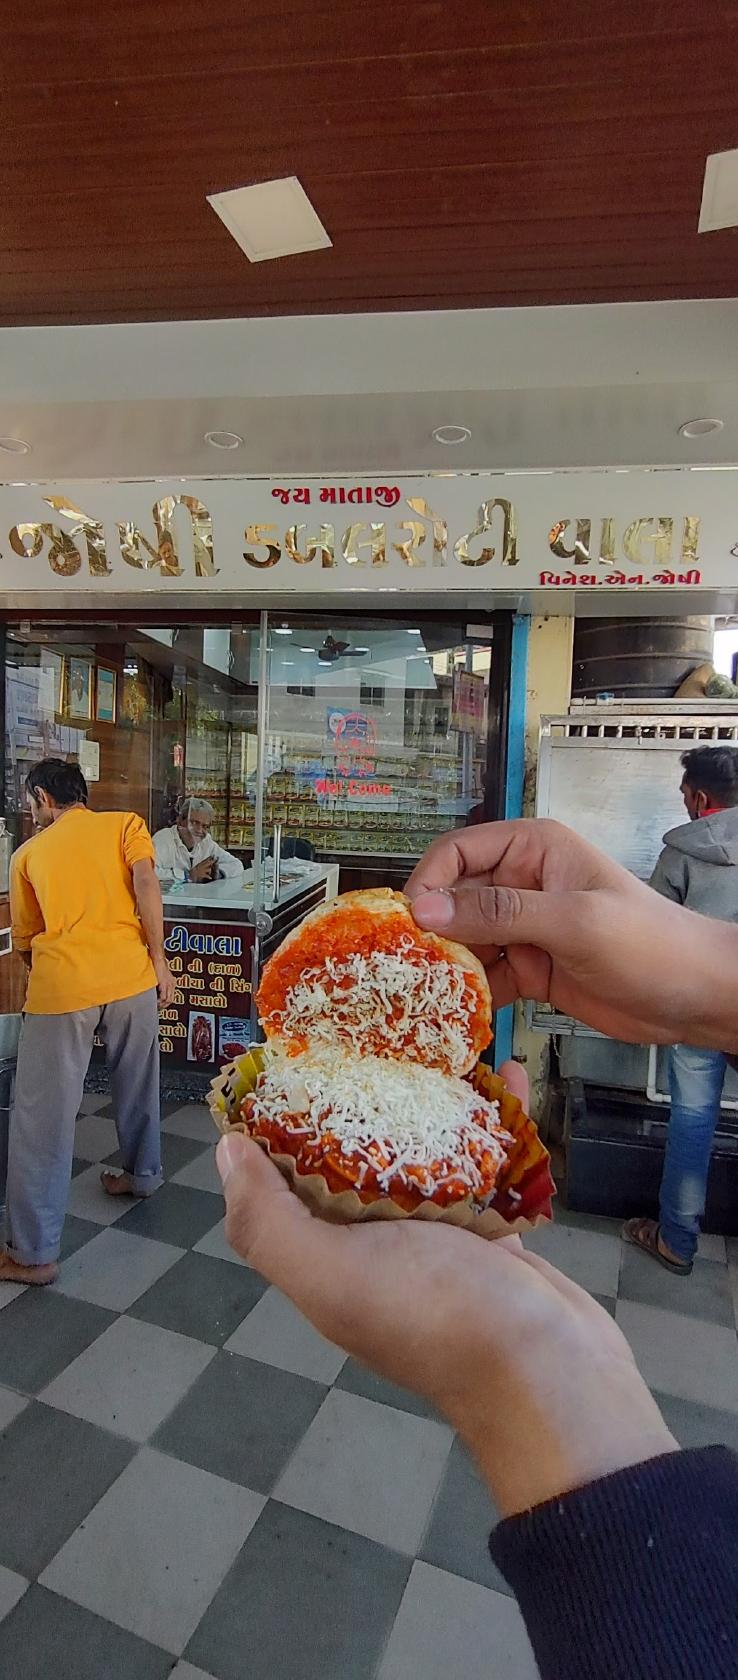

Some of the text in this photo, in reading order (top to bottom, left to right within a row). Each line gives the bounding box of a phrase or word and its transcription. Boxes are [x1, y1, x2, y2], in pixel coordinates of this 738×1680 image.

[271, 486, 400, 507] જય માતાજી
[9, 495, 701, 576] જોષી ડબલરોટી વાલા
[164, 926, 242, 956] ટીવાલા
[187, 958, 203, 973] ની
[176, 974, 205, 990] ળીયા
[209, 976, 224, 992] ની
[190, 993, 227, 1008] મસાલો
[159, 1022, 187, 1038] સાલો
[160, 1037, 174, 1053] લો
